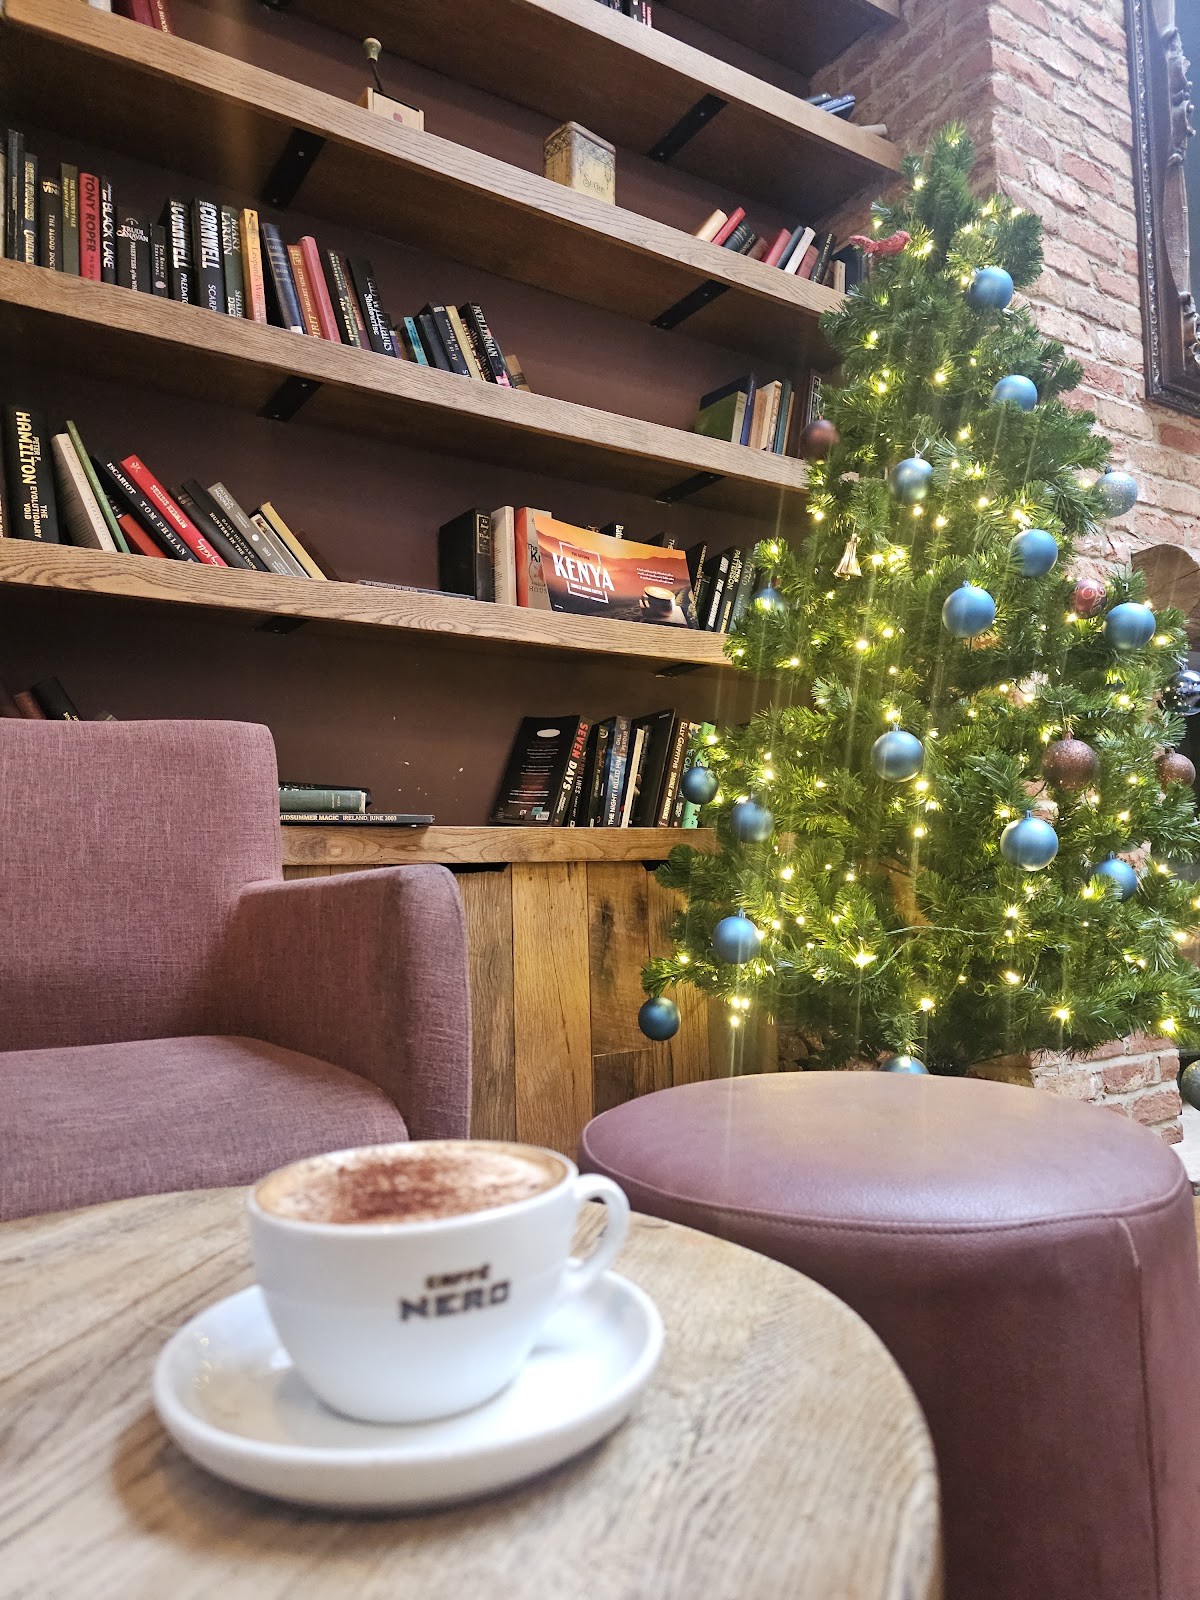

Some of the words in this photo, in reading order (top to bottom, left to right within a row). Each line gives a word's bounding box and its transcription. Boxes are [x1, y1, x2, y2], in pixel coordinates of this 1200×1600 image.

[84, 176, 96, 208] TONY
[85, 212, 97, 253] ROPER
[102, 201, 114, 239] BLACK
[199, 206, 220, 269] CORNWELL
[221, 211, 233, 256] LARKIN
[230, 217, 240, 252] MARY
[102, 241, 115, 270] LAKE
[364, 293, 380, 336] Shadowrise
[16, 411, 37, 485] HAMILTON
[32, 436, 41, 456] PETER
[106, 462, 137, 496] ISCARIOT
[23, 503, 32, 520] VOID
[30, 485, 42, 539] EVOLUTIONARY
[40, 504, 49, 519] THE
[217, 486, 235, 508] PATRICK
[140, 500, 158, 521] TOM
[156, 521, 187, 556] PHELAN
[209, 512, 231, 538] HUNTERS
[229, 536, 237, 545] IN
[235, 543, 246, 556] THE
[551, 552, 616, 592] KENYA
[726, 549, 742, 590] PATTERSON
[571, 722, 589, 759] SEVEN
[677, 721, 688, 738] ELLY
[672, 737, 685, 769] GRIFFITHS
[562, 759, 578, 791] DAYS
[318, 814, 340, 822] MAGIC
[369, 814, 384, 822] JUNE
[607, 813, 616, 826] THE
[609, 792, 618, 814] NIGHT
[400, 1278, 511, 1322] NERO
